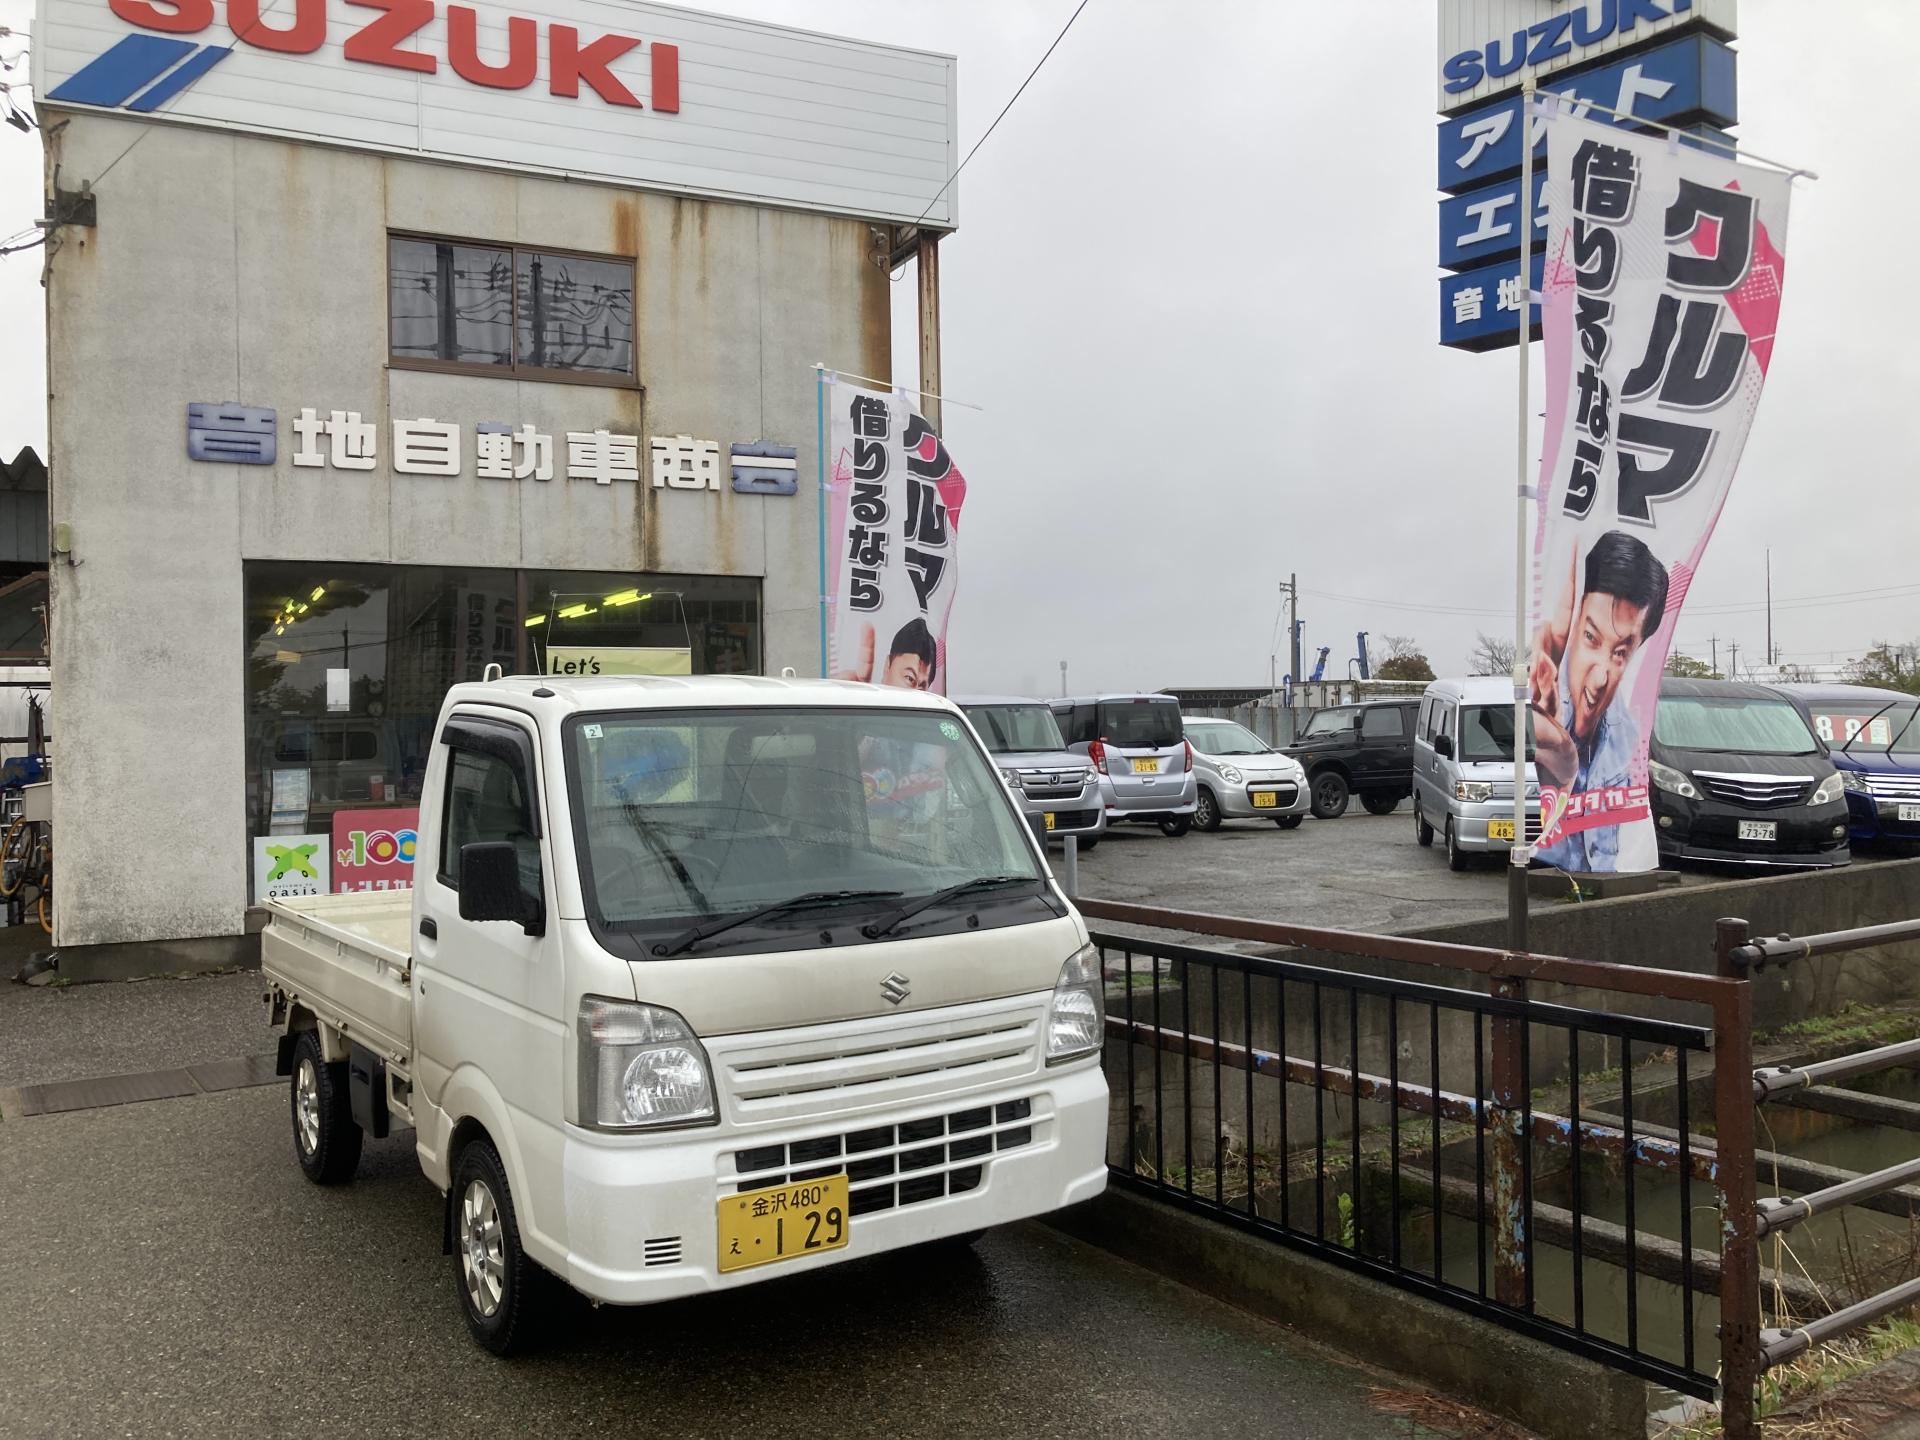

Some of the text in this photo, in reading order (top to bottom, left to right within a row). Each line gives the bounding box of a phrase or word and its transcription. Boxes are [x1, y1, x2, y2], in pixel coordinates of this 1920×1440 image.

[1443, 0, 1691, 94] SUZUK
[1562, 138, 1638, 515] 借りるなら
[1616, 177, 1757, 524] クルマ
[187, 402, 798, 495] 音地自動車商会
[849, 395, 890, 612] 借りるなら
[903, 413, 952, 613] クルマ
[552, 655, 601, 675] Let's
[1746, 828, 1774, 839] 73-78
[269, 886, 317, 898] oasis
